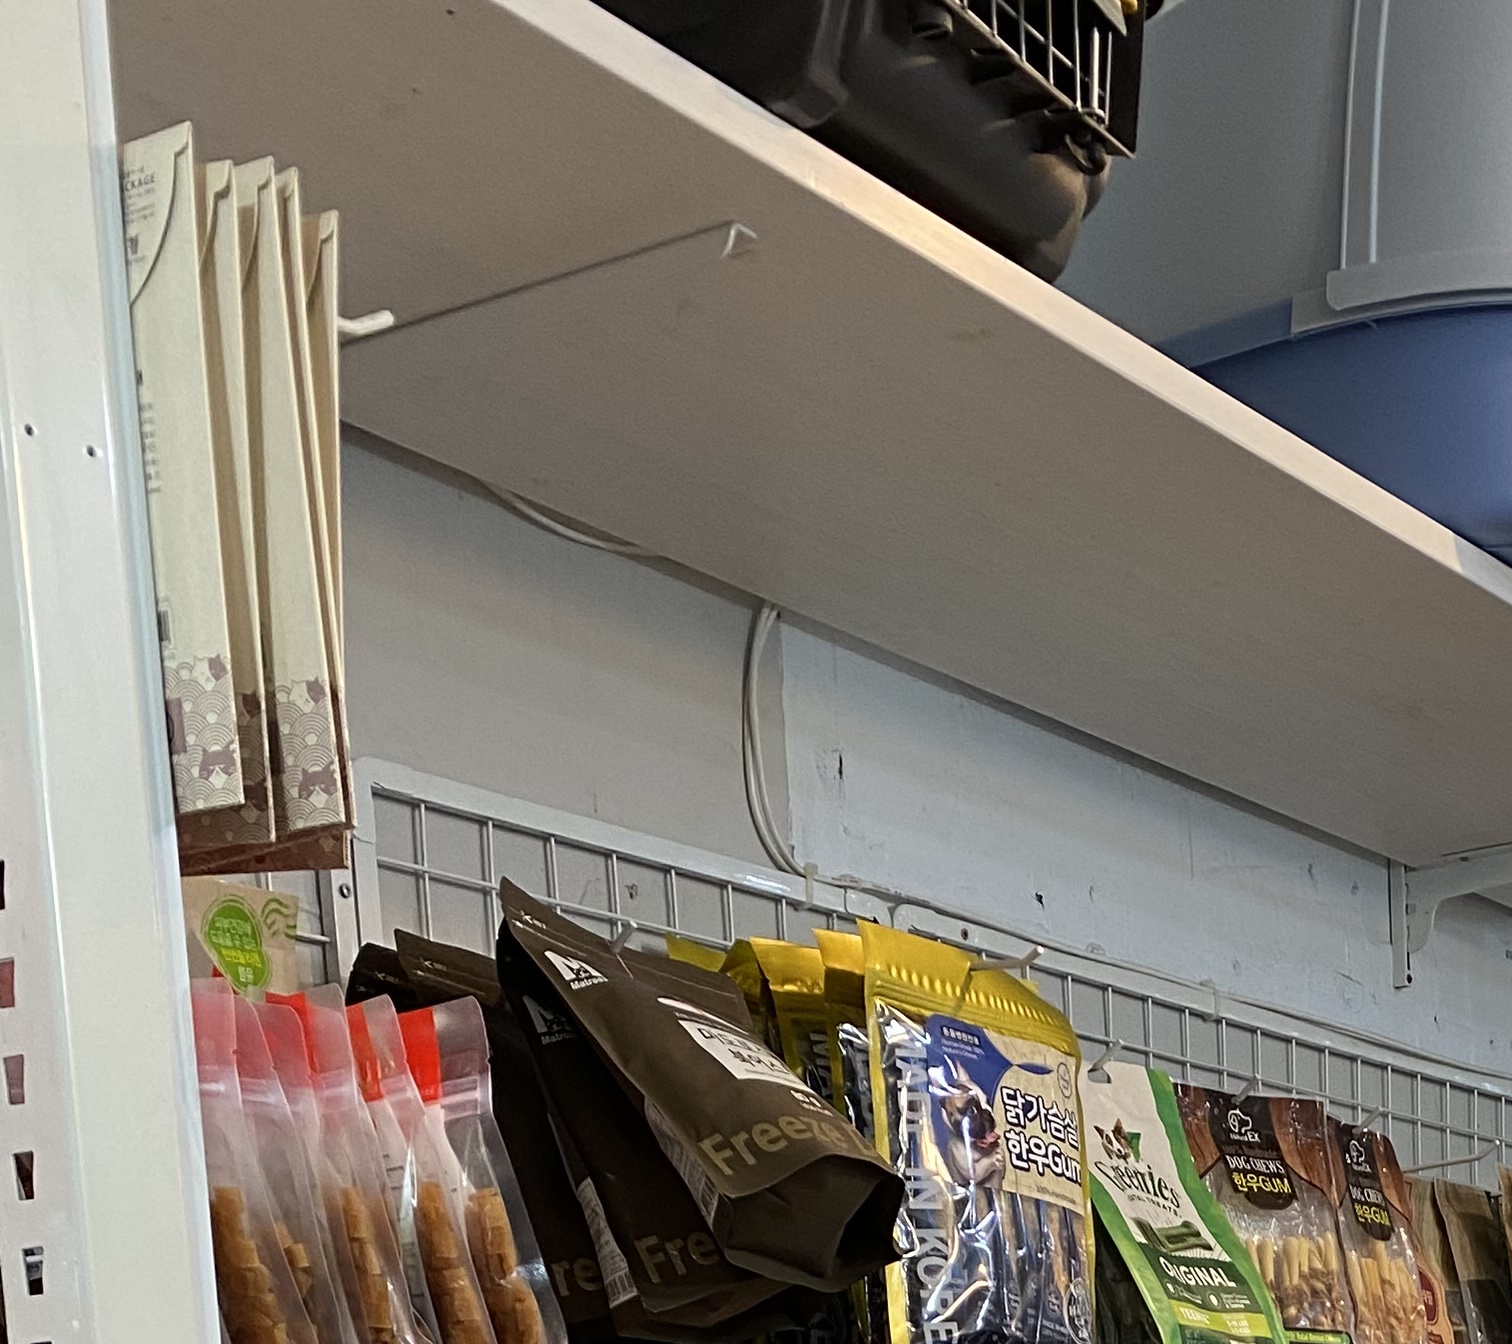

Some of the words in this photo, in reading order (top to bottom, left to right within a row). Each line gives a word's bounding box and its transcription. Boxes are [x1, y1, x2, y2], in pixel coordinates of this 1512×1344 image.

[1001, 1087, 1079, 1150] 닭가슴살
[1225, 1155, 1250, 1171] DOG
[1250, 1157, 1285, 1174] CHEWS
[1232, 1171, 1291, 1194] 한우GUM
[905, 1166, 939, 1211] IN
[634, 1231, 718, 1284] Fre
